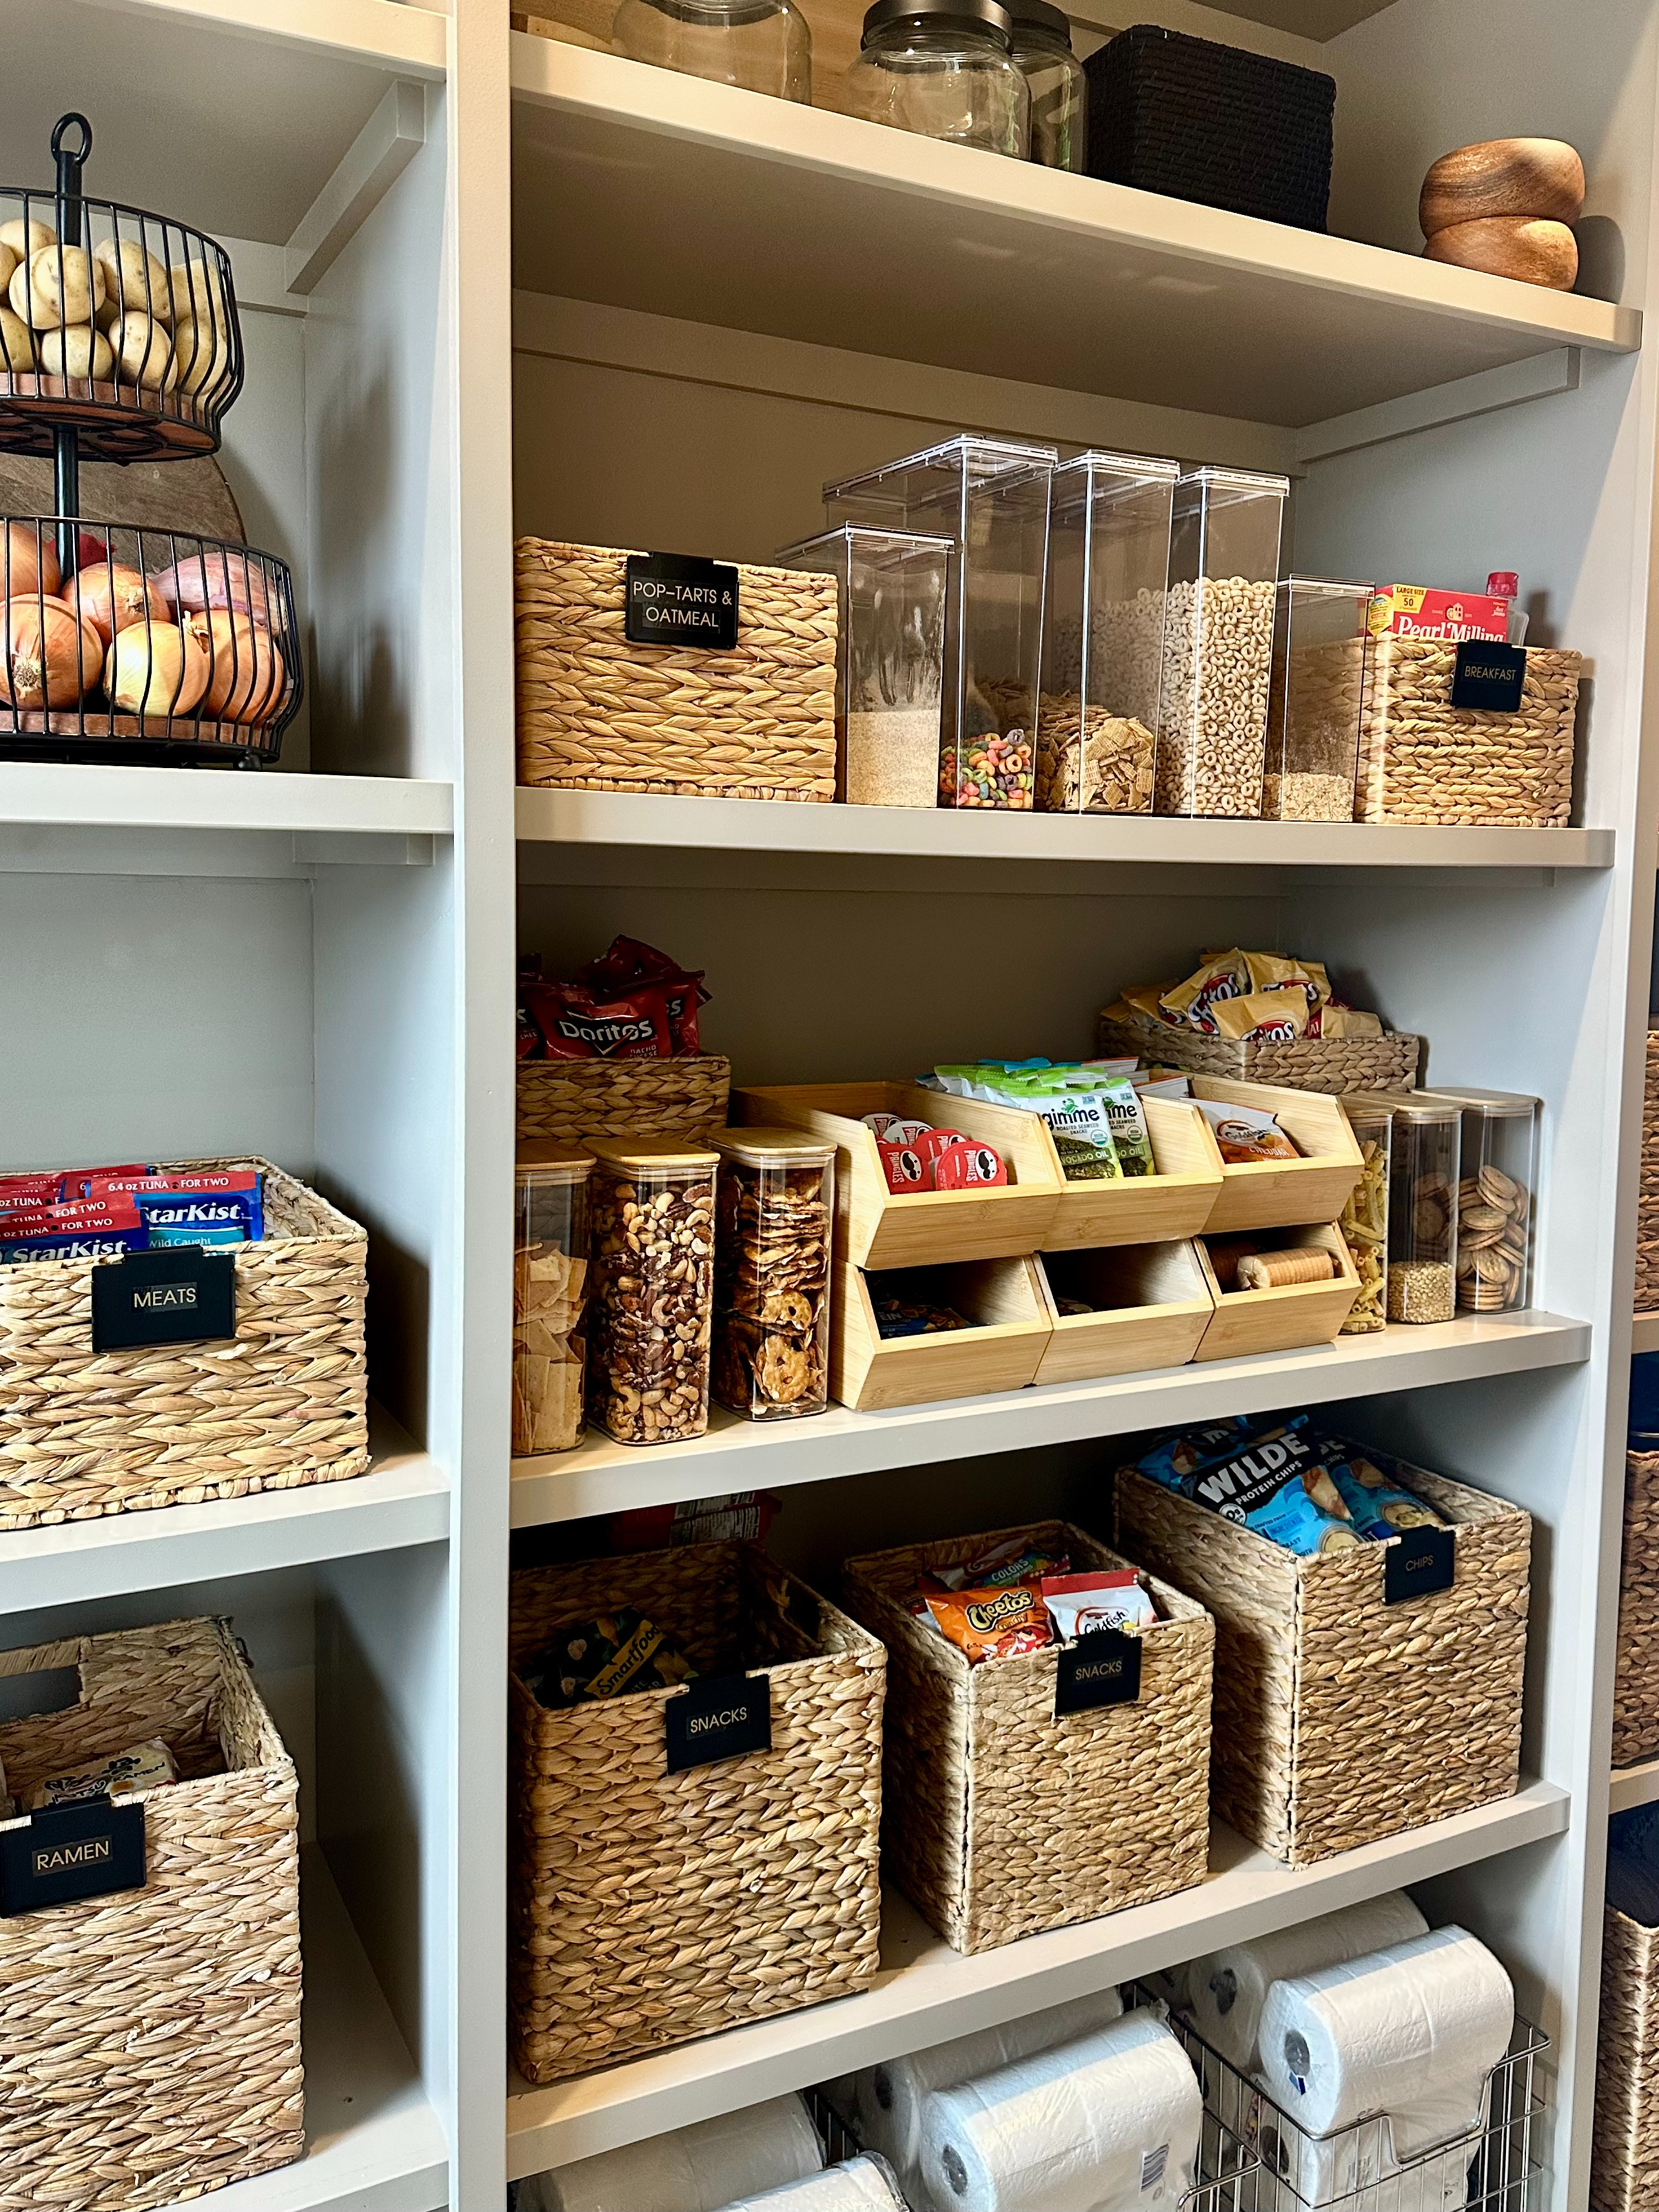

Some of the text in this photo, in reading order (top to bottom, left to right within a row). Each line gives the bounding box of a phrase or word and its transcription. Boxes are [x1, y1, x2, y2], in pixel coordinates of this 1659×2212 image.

[633, 581, 733, 605] POP-TARTS &
[1403, 597, 1414, 606] 50
[646, 607, 719, 627] OATMEAL
[1398, 616, 1445, 640] Pearl
[1464, 665, 1516, 681] BREAKFAST
[559, 1020, 653, 1041] Doritos
[630, 1044, 656, 1054] NACHO
[1043, 1108, 1100, 1131] gimme
[1095, 1150, 1109, 1159] OIL
[1130, 1147, 1143, 1155] OIL
[1248, 1147, 1290, 1156] CHEDDAR
[887, 1152, 905, 1183] PRINGLES
[964, 1150, 979, 1182] PRINGLES
[108, 1182, 123, 1192] 6.4
[139, 1181, 169, 1190] TUNA
[181, 1179, 201, 1188] FOR
[203, 1177, 229, 1186] TWO
[56, 1207, 78, 1218] FOR
[79, 1201, 107, 1214] TWO
[19, 1226, 49, 1236] TUNA
[61, 1221, 83, 1230] FOR
[85, 1218, 113, 1227] TWO
[12, 1239, 127, 1263] StarKist
[174, 1237, 211, 1246] Caught
[133, 1287, 197, 1308] MEATS
[1197, 1432, 1310, 1504] WILDE
[1236, 1460, 1303, 1505] PROTEIN CHIPS
[1405, 1555, 1434, 1572] CHIPS
[968, 1590, 1033, 1633] Cheetos
[596, 1624, 660, 1694] Smartfood
[1075, 1659, 1123, 1680] SNACKS
[690, 1707, 748, 1734] SNACKS
[37, 1840, 109, 1871] RAMEN
